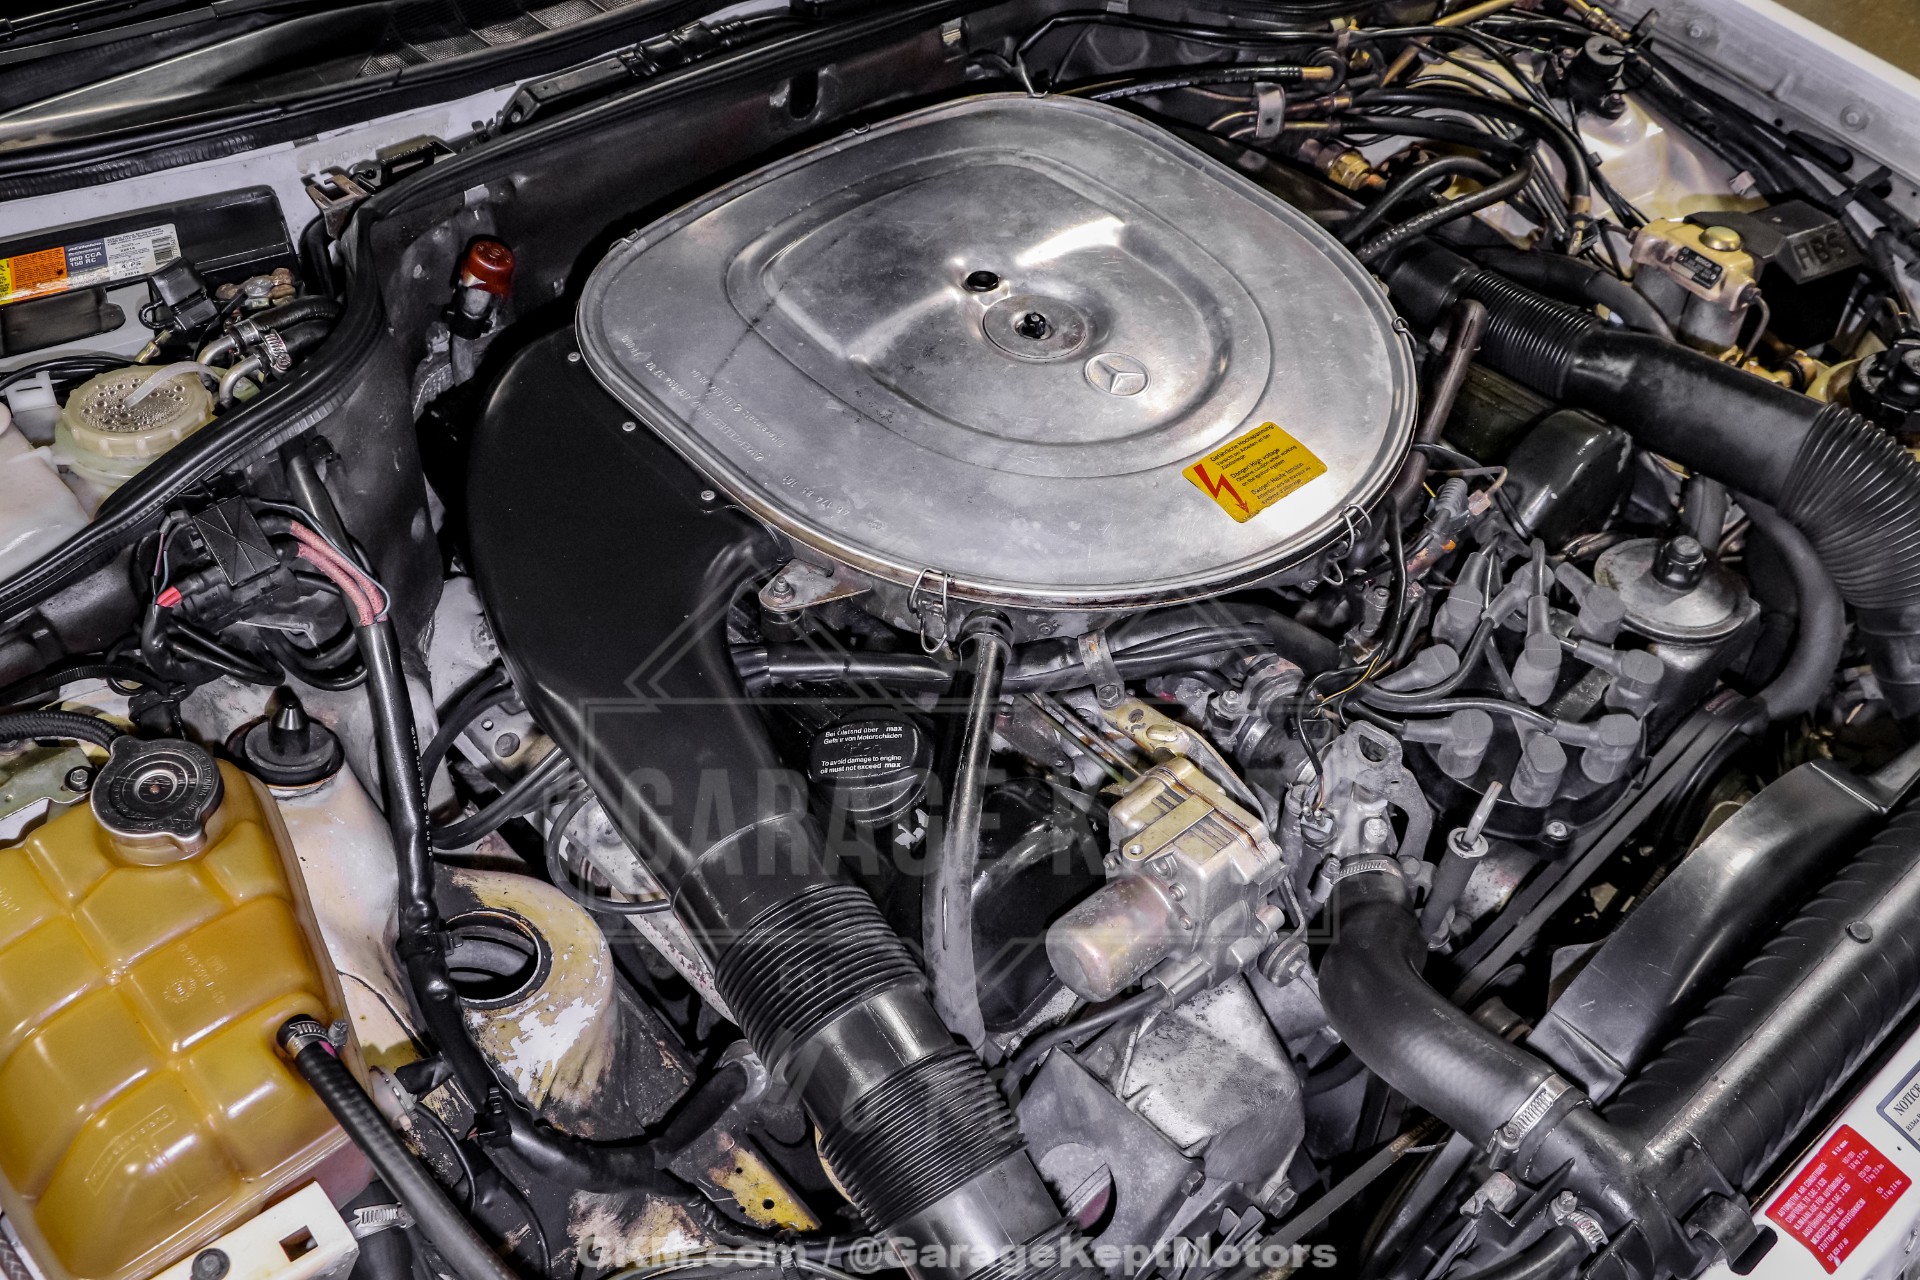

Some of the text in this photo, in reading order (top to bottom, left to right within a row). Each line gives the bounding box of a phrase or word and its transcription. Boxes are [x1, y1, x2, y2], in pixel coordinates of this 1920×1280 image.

[1796, 231, 1846, 271] ABS
[1230, 449, 1280, 478] Danger! High voltage
[857, 733, 903, 741] Motorschäden
[829, 765, 845, 773] must
[1893, 1083, 1920, 1116] NOTICE
[1778, 1163, 1826, 1216] AUTOMOTIVE AIR CONDITIONER
[1794, 1174, 1845, 1230] KLIMAANLAGE FÜR AUTOMOBILE
[1808, 1188, 1818, 1198] SAE
[1803, 1212, 1825, 1237] AUSFÜHRUNG
[1823, 1201, 1834, 1213] NACH
[1832, 1193, 1841, 1203] SAE
[1811, 1214, 1838, 1244] MERCEDES-BENZ
[1838, 1198, 1865, 1229] UNTERTÜRKHEIM
